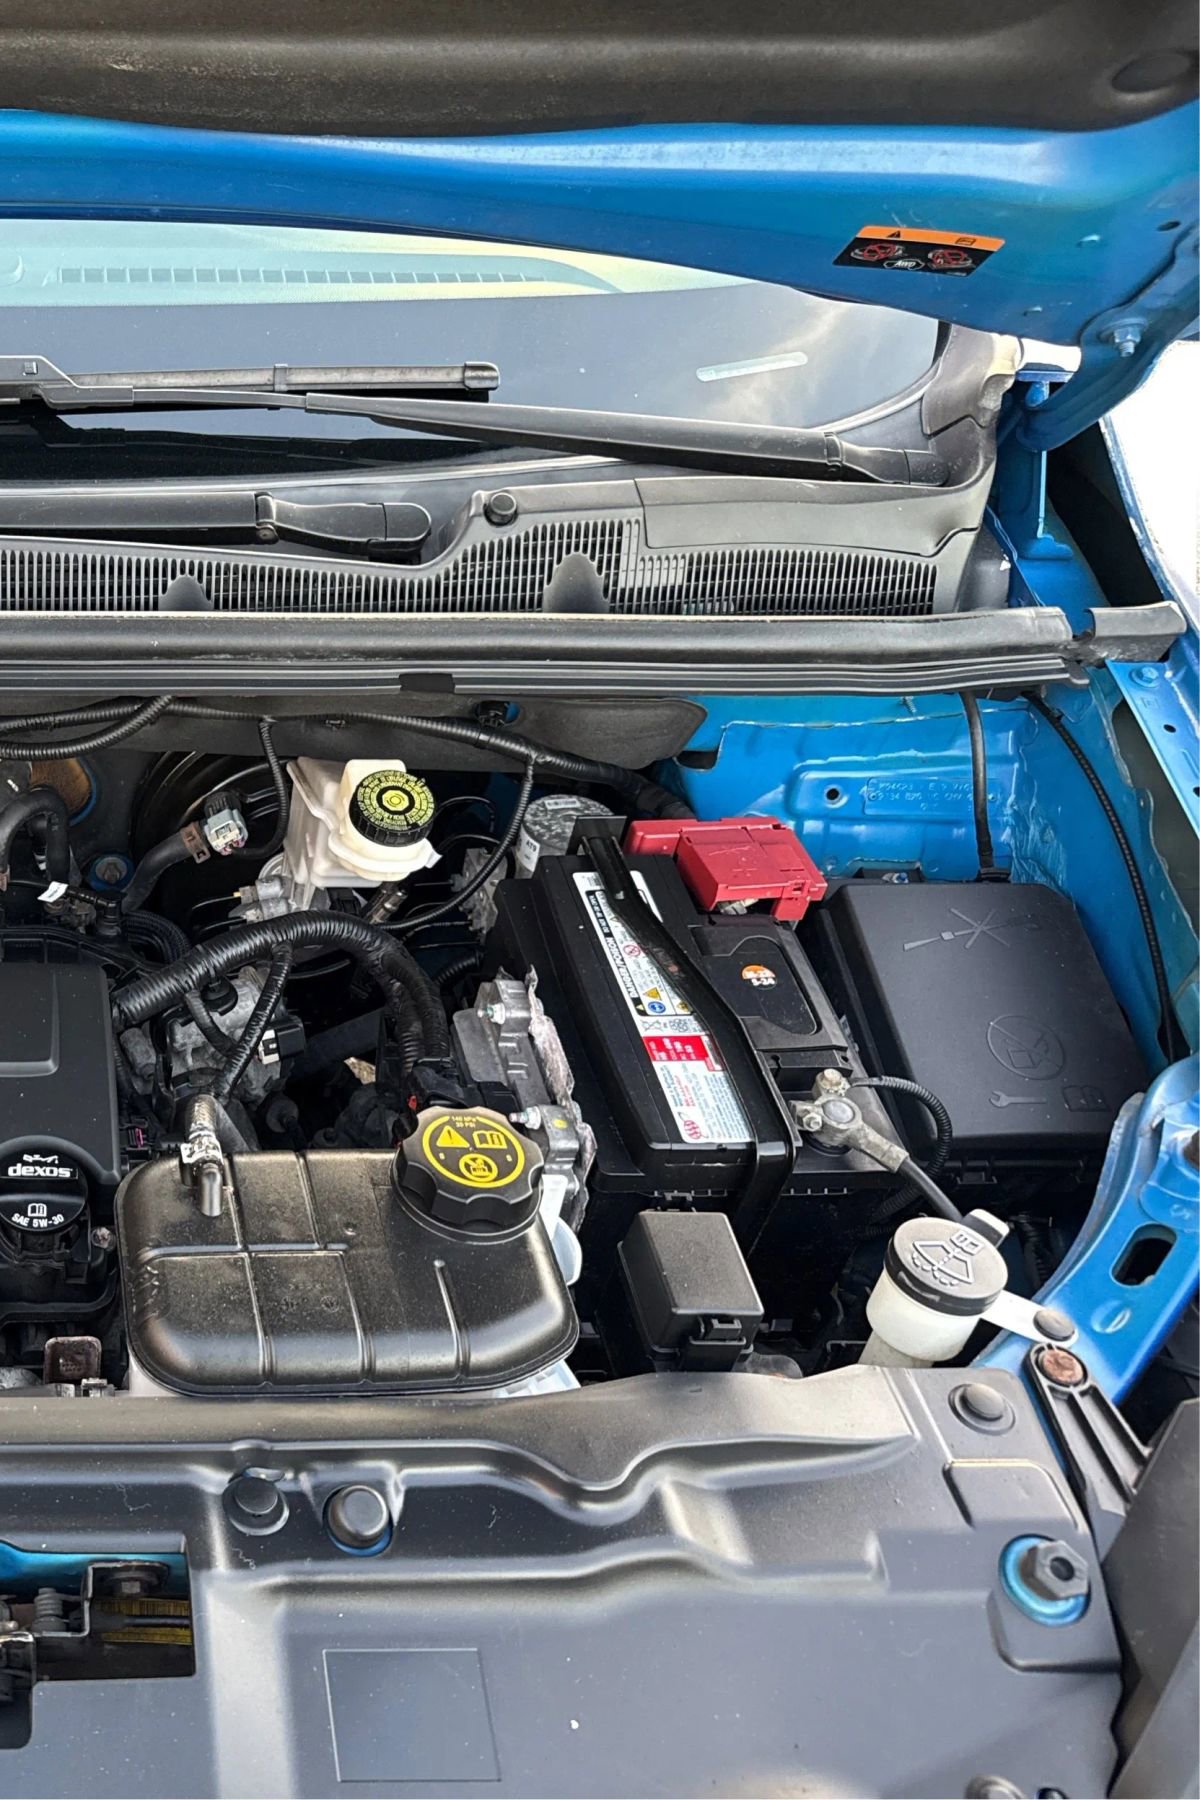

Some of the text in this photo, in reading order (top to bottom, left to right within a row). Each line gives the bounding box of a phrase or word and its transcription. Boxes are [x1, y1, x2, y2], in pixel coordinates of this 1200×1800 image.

[7, 1162, 71, 1178] dexos
[11, 1213, 64, 1228] SAE 5W-30
